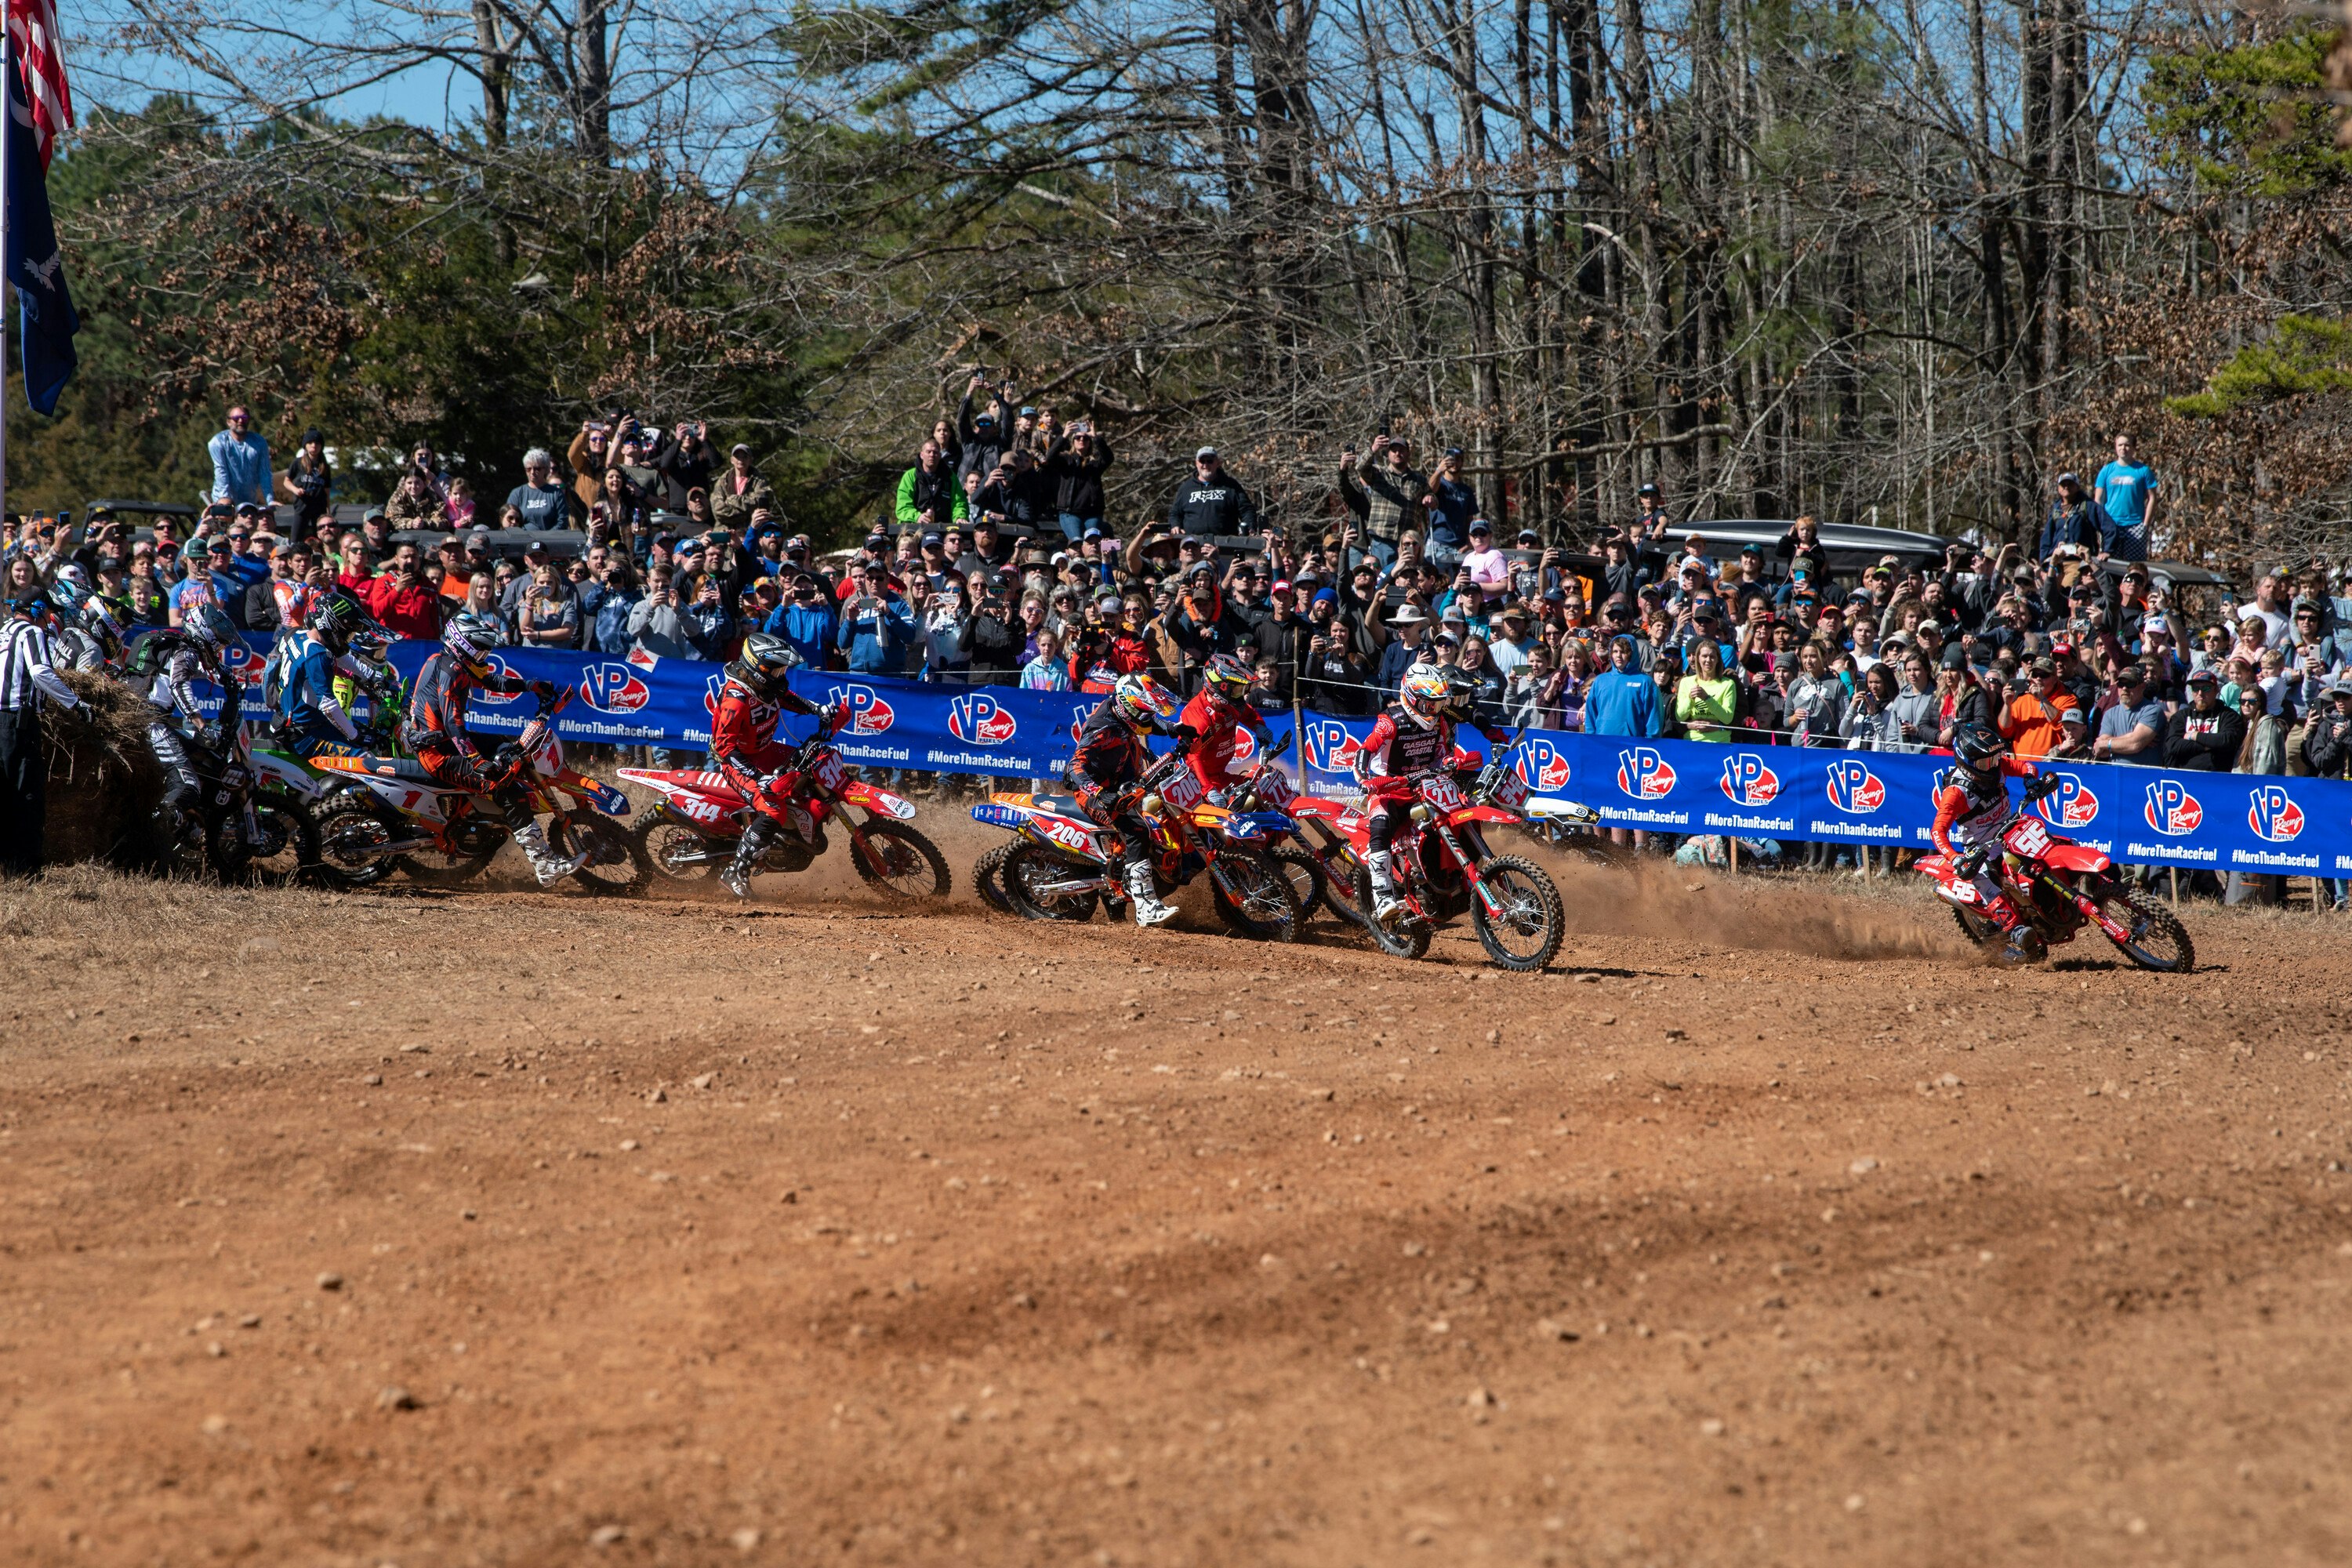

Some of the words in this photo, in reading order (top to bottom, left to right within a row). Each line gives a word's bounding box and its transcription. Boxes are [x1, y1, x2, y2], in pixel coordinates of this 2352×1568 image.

[1189, 490, 1226, 503] FOX
[583, 662, 630, 711] VP
[612, 691, 648, 706] Racing
[858, 713, 892, 728] Racing
[951, 693, 997, 742] VP
[559, 719, 664, 739] #MoreThanRaceFuel
[979, 722, 1014, 738] Racing
[1305, 720, 1347, 771] VP
[1403, 739, 1436, 750] GASGAS
[1405, 746, 1433, 757] COASTAL
[819, 750, 844, 789] 314
[927, 750, 1031, 771] #MoreThanRaceFuel
[1145, 753, 1171, 777] RENTHAL
[1518, 739, 1555, 790] VP
[1542, 768, 1569, 783] Racing
[1618, 747, 1661, 798] VP
[1723, 753, 1763, 805] VP
[1171, 772, 1202, 807] 206
[1501, 773, 1526, 806] 342
[1644, 775, 1675, 791] Racing
[1748, 782, 1777, 798] Racing
[1827, 760, 1868, 812] VP
[401, 790, 423, 810] 1
[610, 794, 624, 813] KTM
[1432, 784, 1459, 807] 212
[1854, 789, 1884, 805] Racing
[681, 797, 721, 823] 314
[1599, 806, 1688, 824] #MoreThanRaceFuel
[2066, 802, 2098, 819] Racing
[2145, 779, 2187, 834] VP
[2249, 785, 2288, 840] VP
[1704, 813, 1794, 831] #MoreThanRaceFuel
[2171, 810, 2201, 826] Racing
[2274, 816, 2303, 833] Racing
[1047, 822, 1087, 849] 206
[1239, 821, 1256, 837] KTM
[1811, 821, 1901, 838] #MoreThanRaceFuel
[2127, 842, 2217, 861] #MoreThanRaceFuel
[2232, 849, 2319, 868] #MoreThanRaceFuel
[1951, 880, 1976, 902] 515
